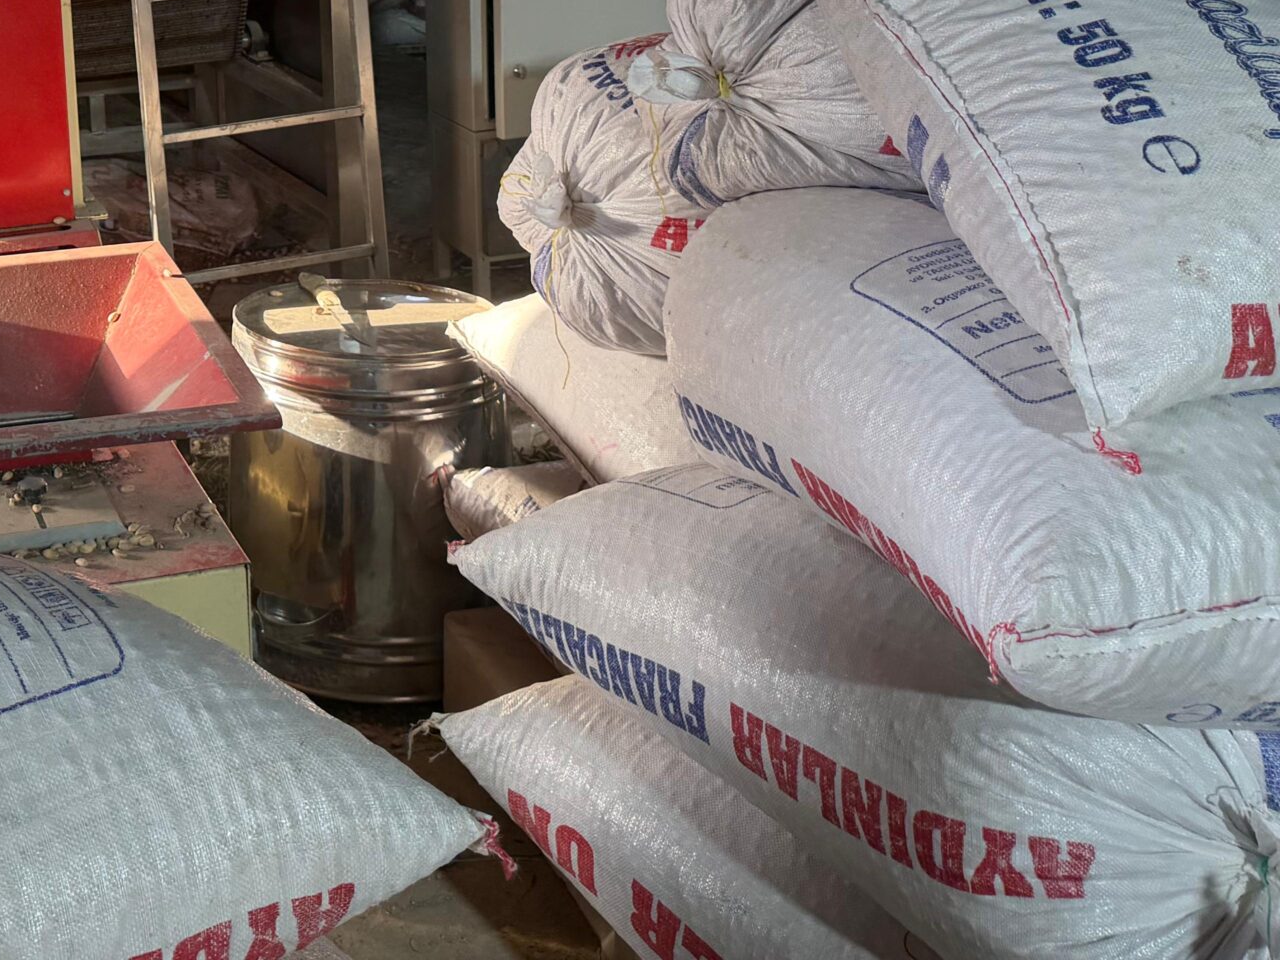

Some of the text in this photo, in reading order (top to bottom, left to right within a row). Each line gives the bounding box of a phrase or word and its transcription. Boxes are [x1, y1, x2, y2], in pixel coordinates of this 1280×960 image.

[1056, 18, 1133, 68] 50
[1093, 72, 1166, 125] kg
[730, 702, 1097, 899] AYDINLAR
[507, 789, 598, 898] UN
